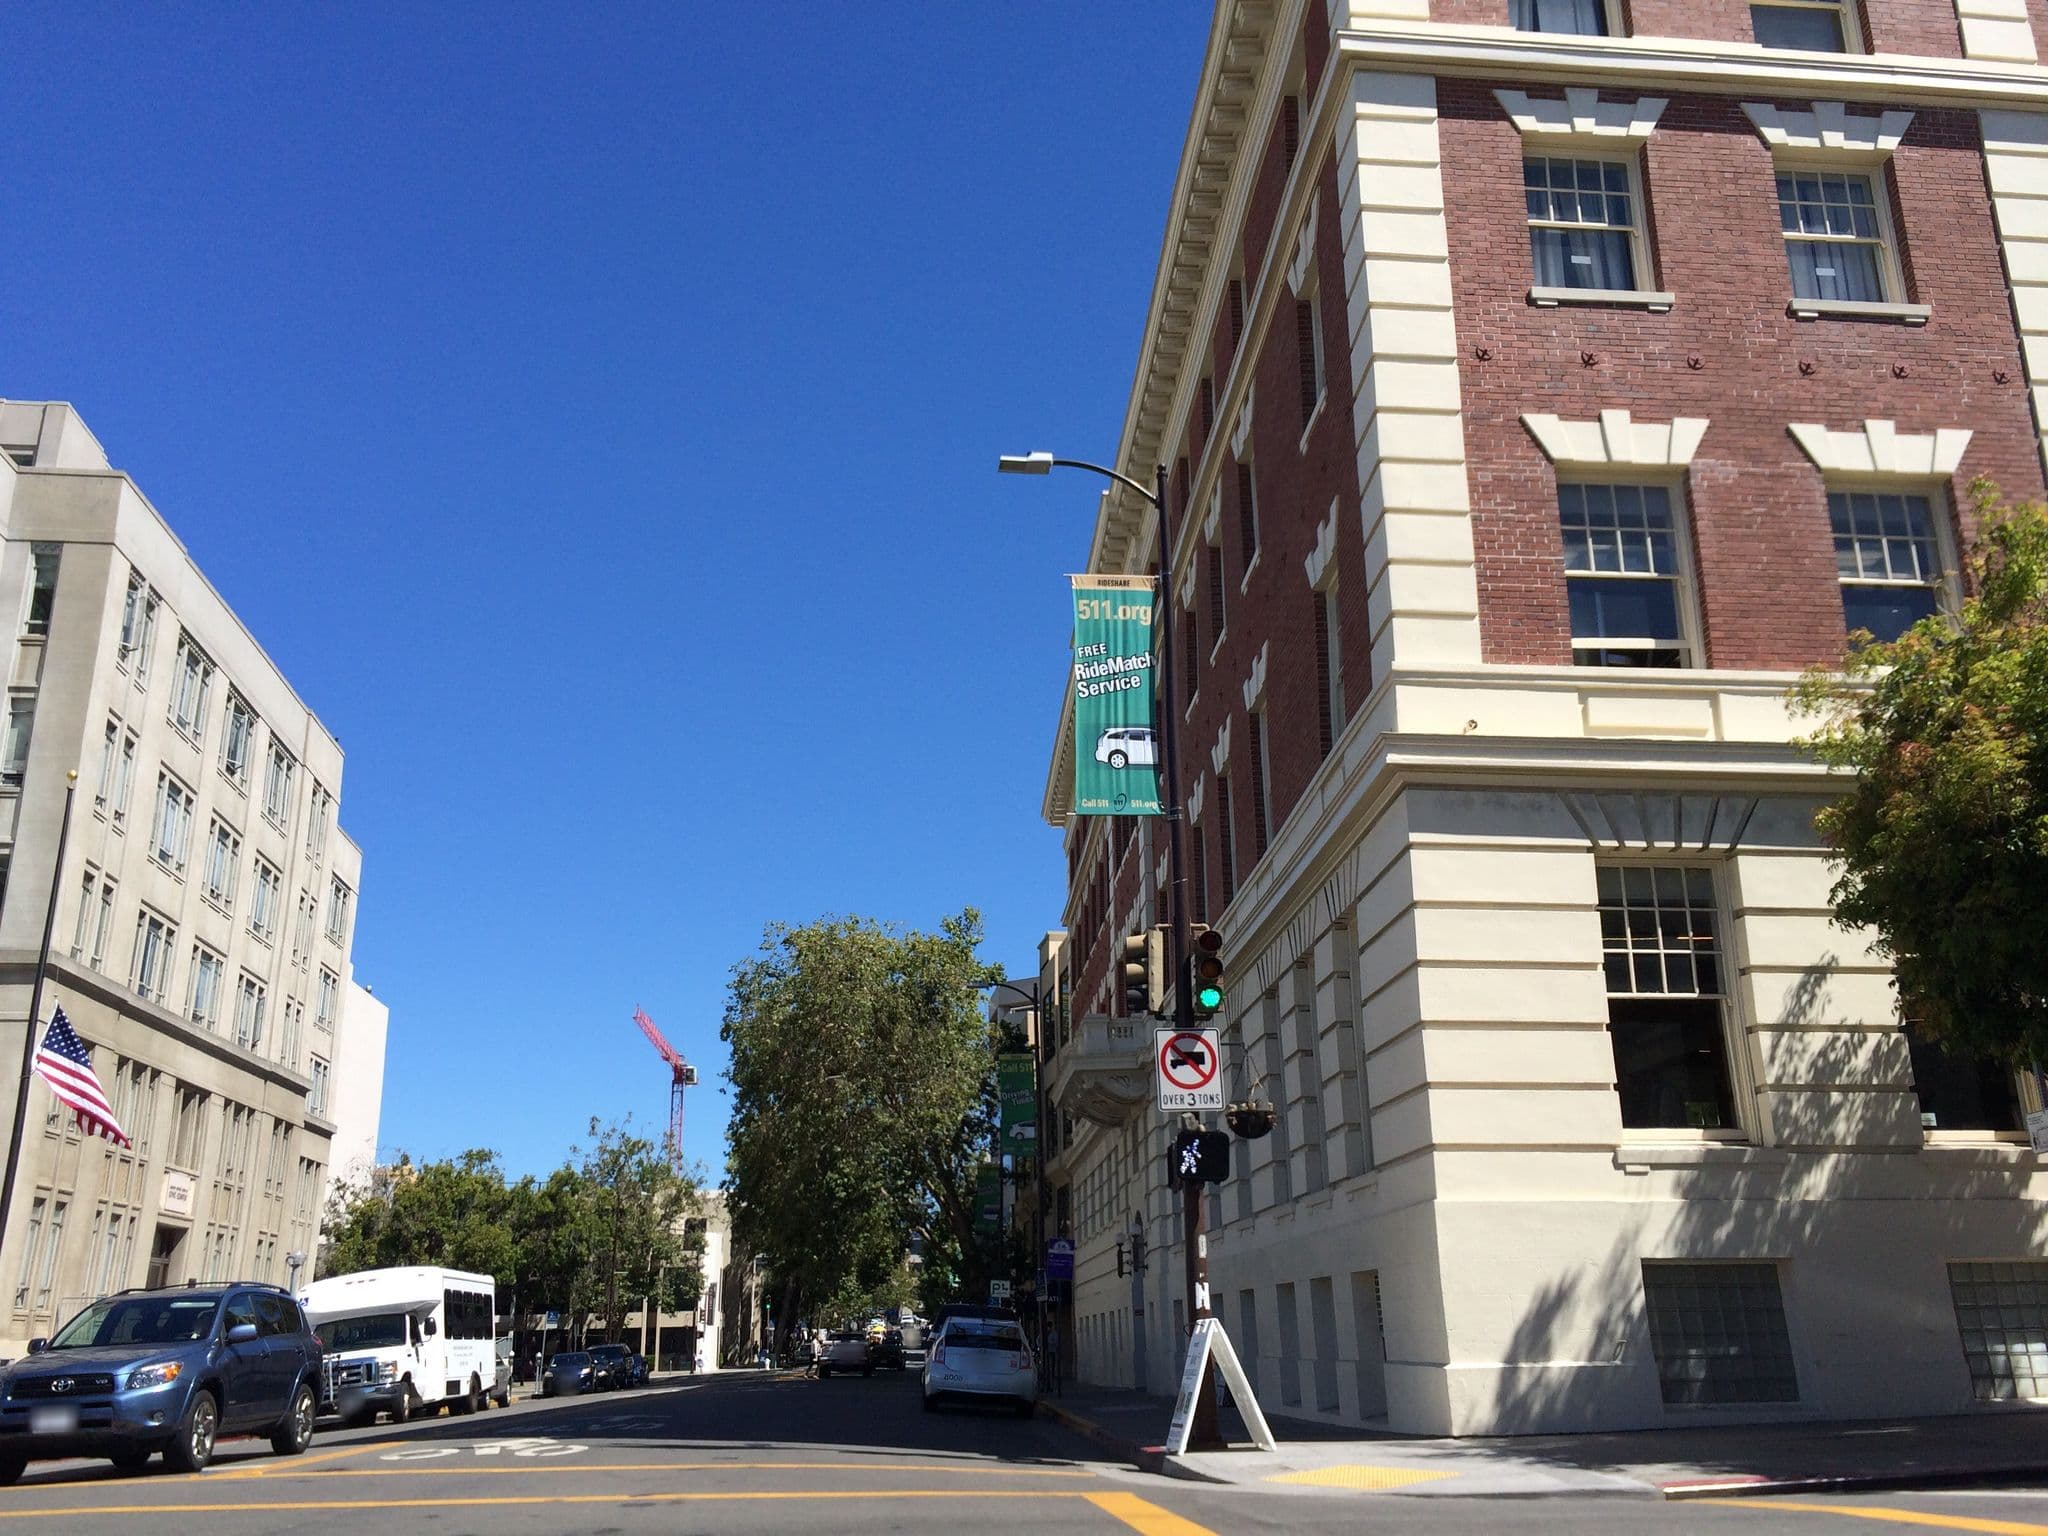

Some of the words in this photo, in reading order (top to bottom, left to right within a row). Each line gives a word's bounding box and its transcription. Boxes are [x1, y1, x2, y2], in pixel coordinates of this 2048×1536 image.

[1097, 579, 1131, 587] RIDESHARE
[1078, 599, 1152, 625] 511.org
[1077, 643, 1107, 658] FREE
[1074, 651, 1157, 681] RideMatch
[1077, 675, 1141, 698] Service
[1163, 1094, 1185, 1105] OVER
[1187, 1093, 1197, 1106] 3
[1197, 1093, 1221, 1105] TONS
